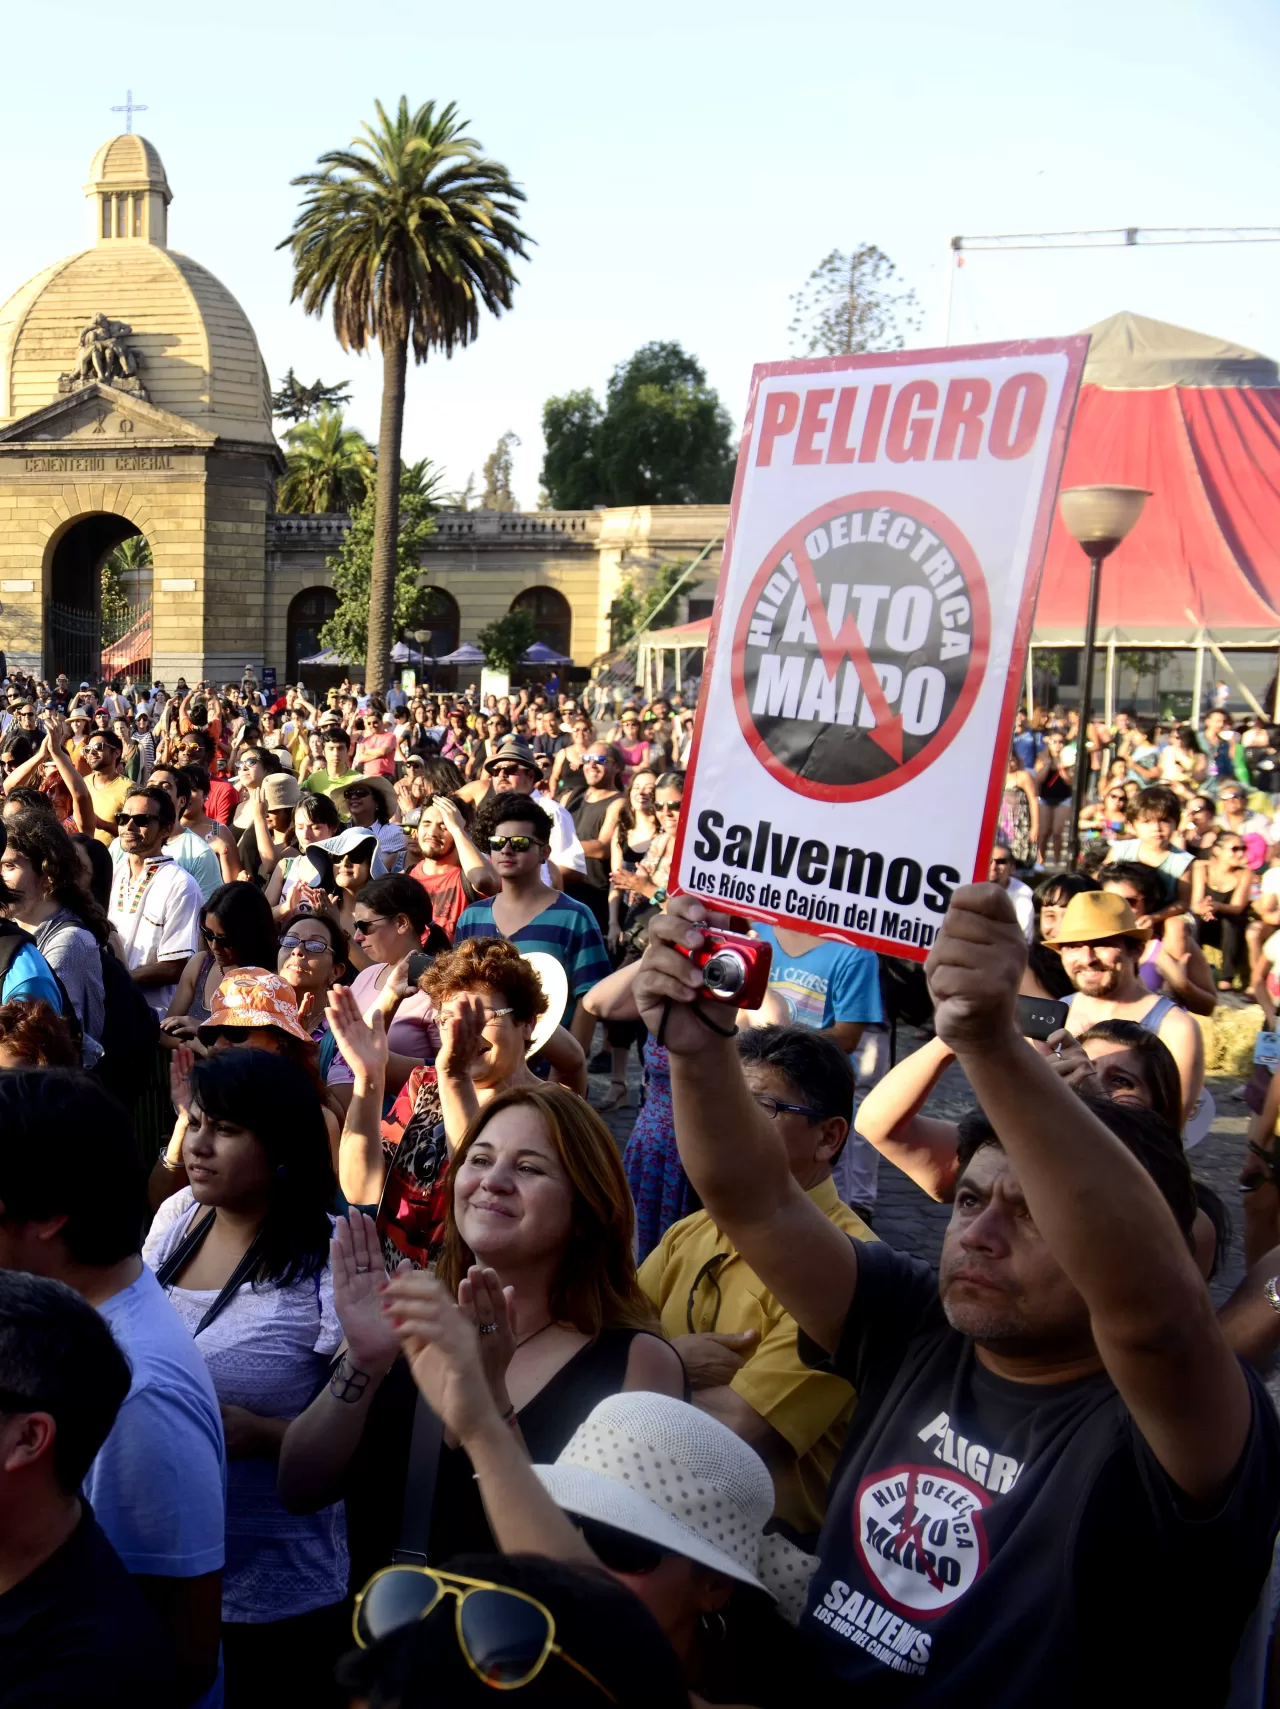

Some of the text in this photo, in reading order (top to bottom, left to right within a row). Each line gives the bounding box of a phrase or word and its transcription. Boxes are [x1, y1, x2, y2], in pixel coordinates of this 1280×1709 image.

[755, 372, 1047, 467] PELIGRO
[25, 458, 105, 473] CEMENTERIO
[781, 583, 933, 653] ALTO
[752, 653, 946, 736] MAIPO
[689, 865, 716, 892] Los
[719, 872, 755, 904] Ríos
[758, 883, 781, 909] de
[785, 889, 840, 924] Cajón
[843, 903, 877, 933] del
[693, 809, 960, 914] Salvemos
[917, 1411, 1025, 1495] PLIGR
[813, 1604, 834, 1625] LOS
[830, 1616, 856, 1638] RIOS
[850, 1629, 871, 1648] DEL
[890, 1655, 928, 1676] MAIPO
